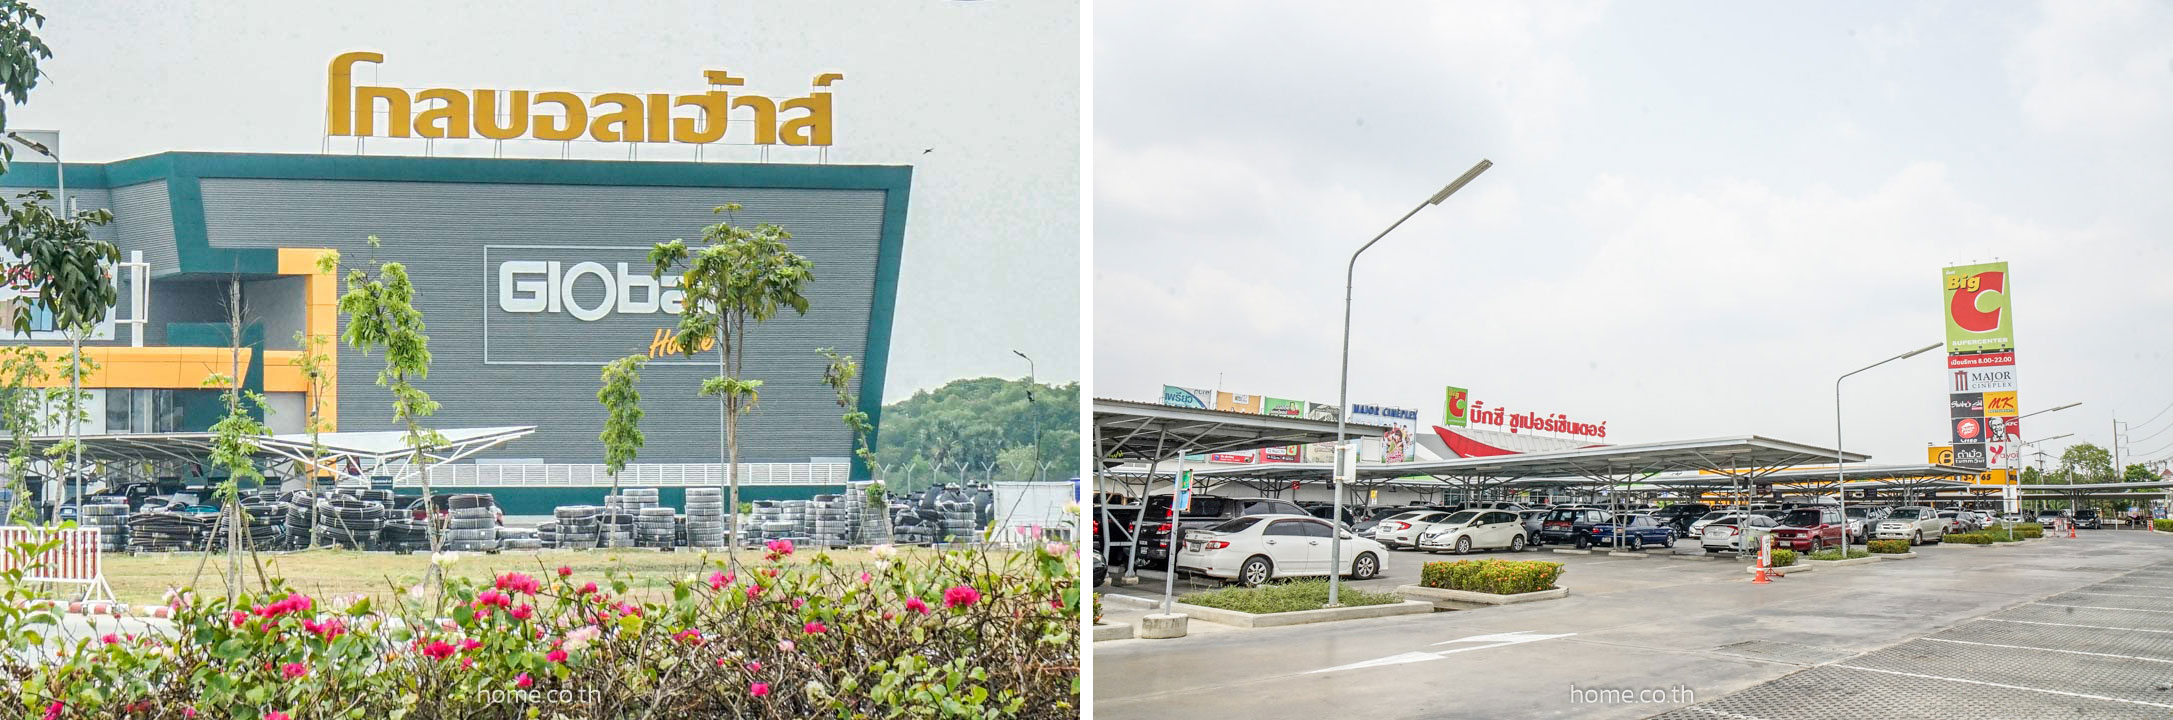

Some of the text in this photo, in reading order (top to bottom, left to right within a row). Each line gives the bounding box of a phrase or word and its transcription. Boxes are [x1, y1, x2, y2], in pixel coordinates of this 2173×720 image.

[328, 51, 843, 146] โกลบอลเฮ้าส์
[1947, 271, 2005, 333] Big C
[649, 328, 716, 359] Hoe
[1952, 337, 2009, 346] SUPERCENTER
[1978, 356, 2012, 364] 8.00-22.00
[1972, 371, 2012, 382] MAJOR
[1353, 404, 1418, 420] MAJOR CINEPLEX
[1449, 391, 1467, 418] C
[1988, 396, 2014, 409] MK
[1470, 400, 1607, 438] บิ๊กซี ซูเปอร์เซ็นเตอร์
